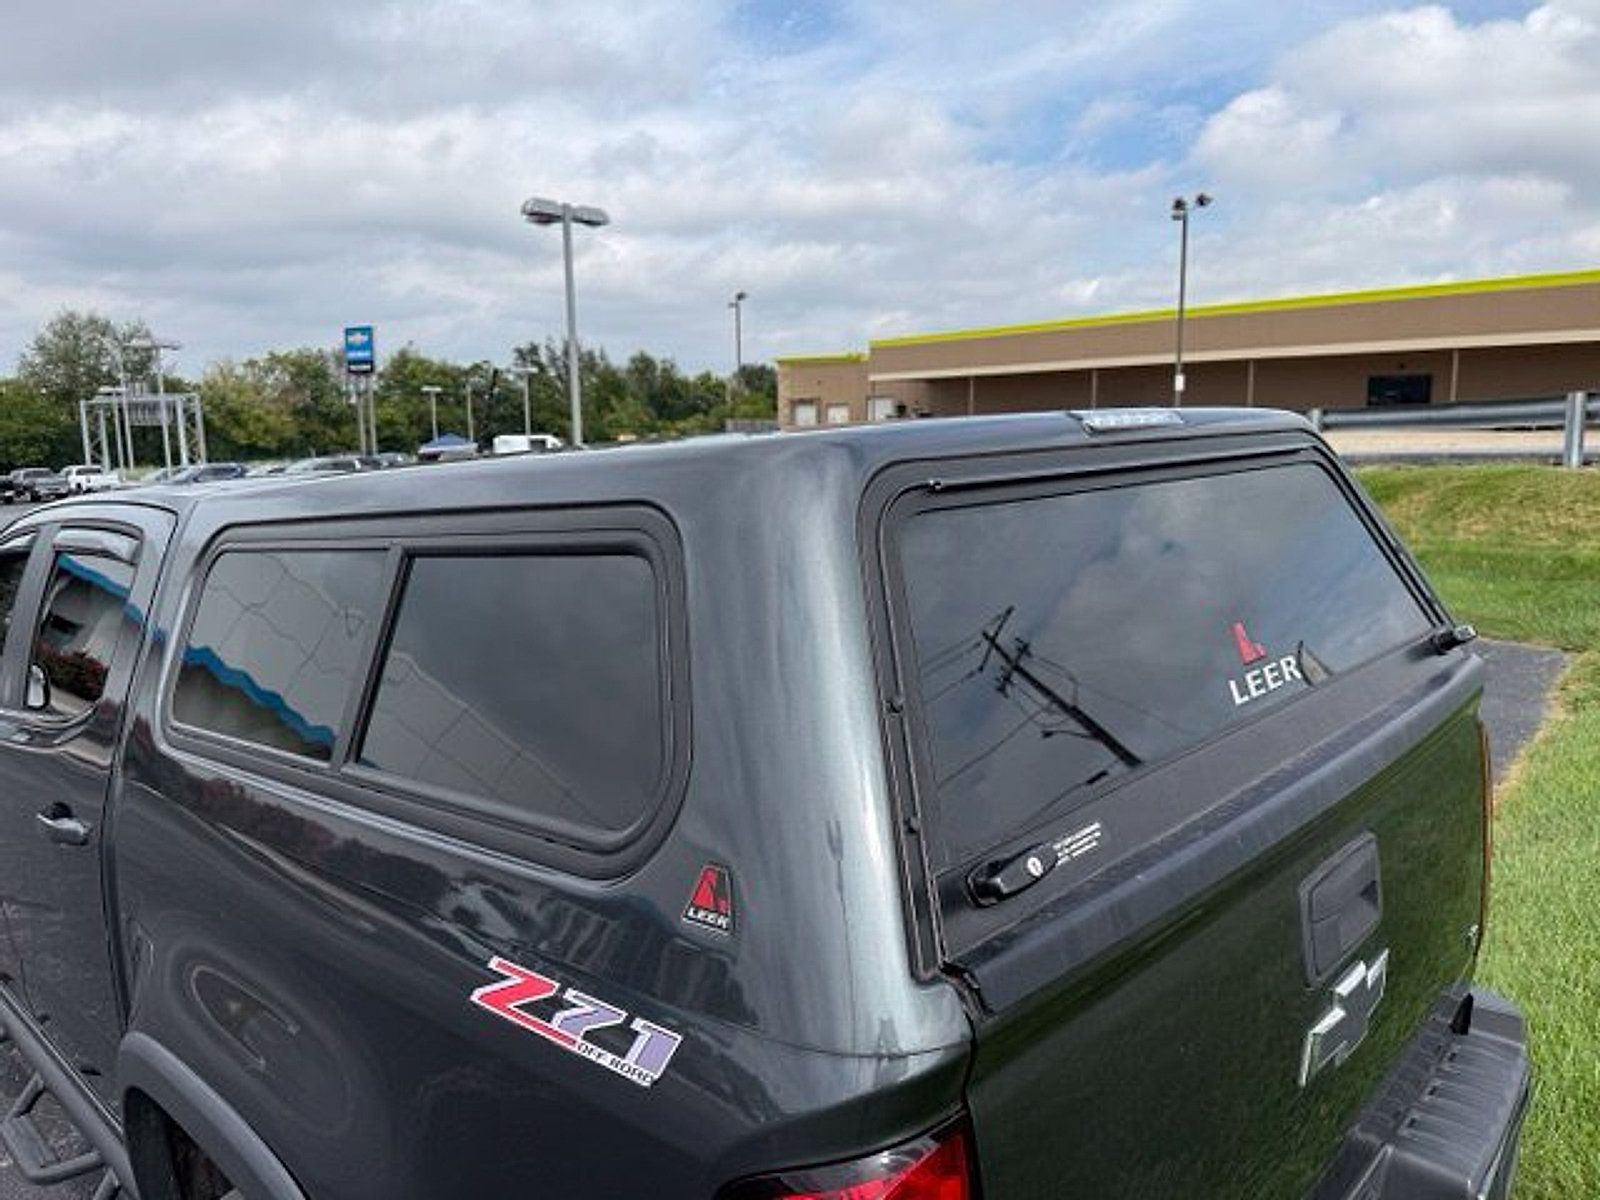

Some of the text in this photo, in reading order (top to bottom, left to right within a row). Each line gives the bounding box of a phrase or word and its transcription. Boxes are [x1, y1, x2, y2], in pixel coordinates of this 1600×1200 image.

[1229, 655, 1302, 706] LEER
[687, 907, 730, 929] LEER
[470, 956, 683, 1080] Z71
